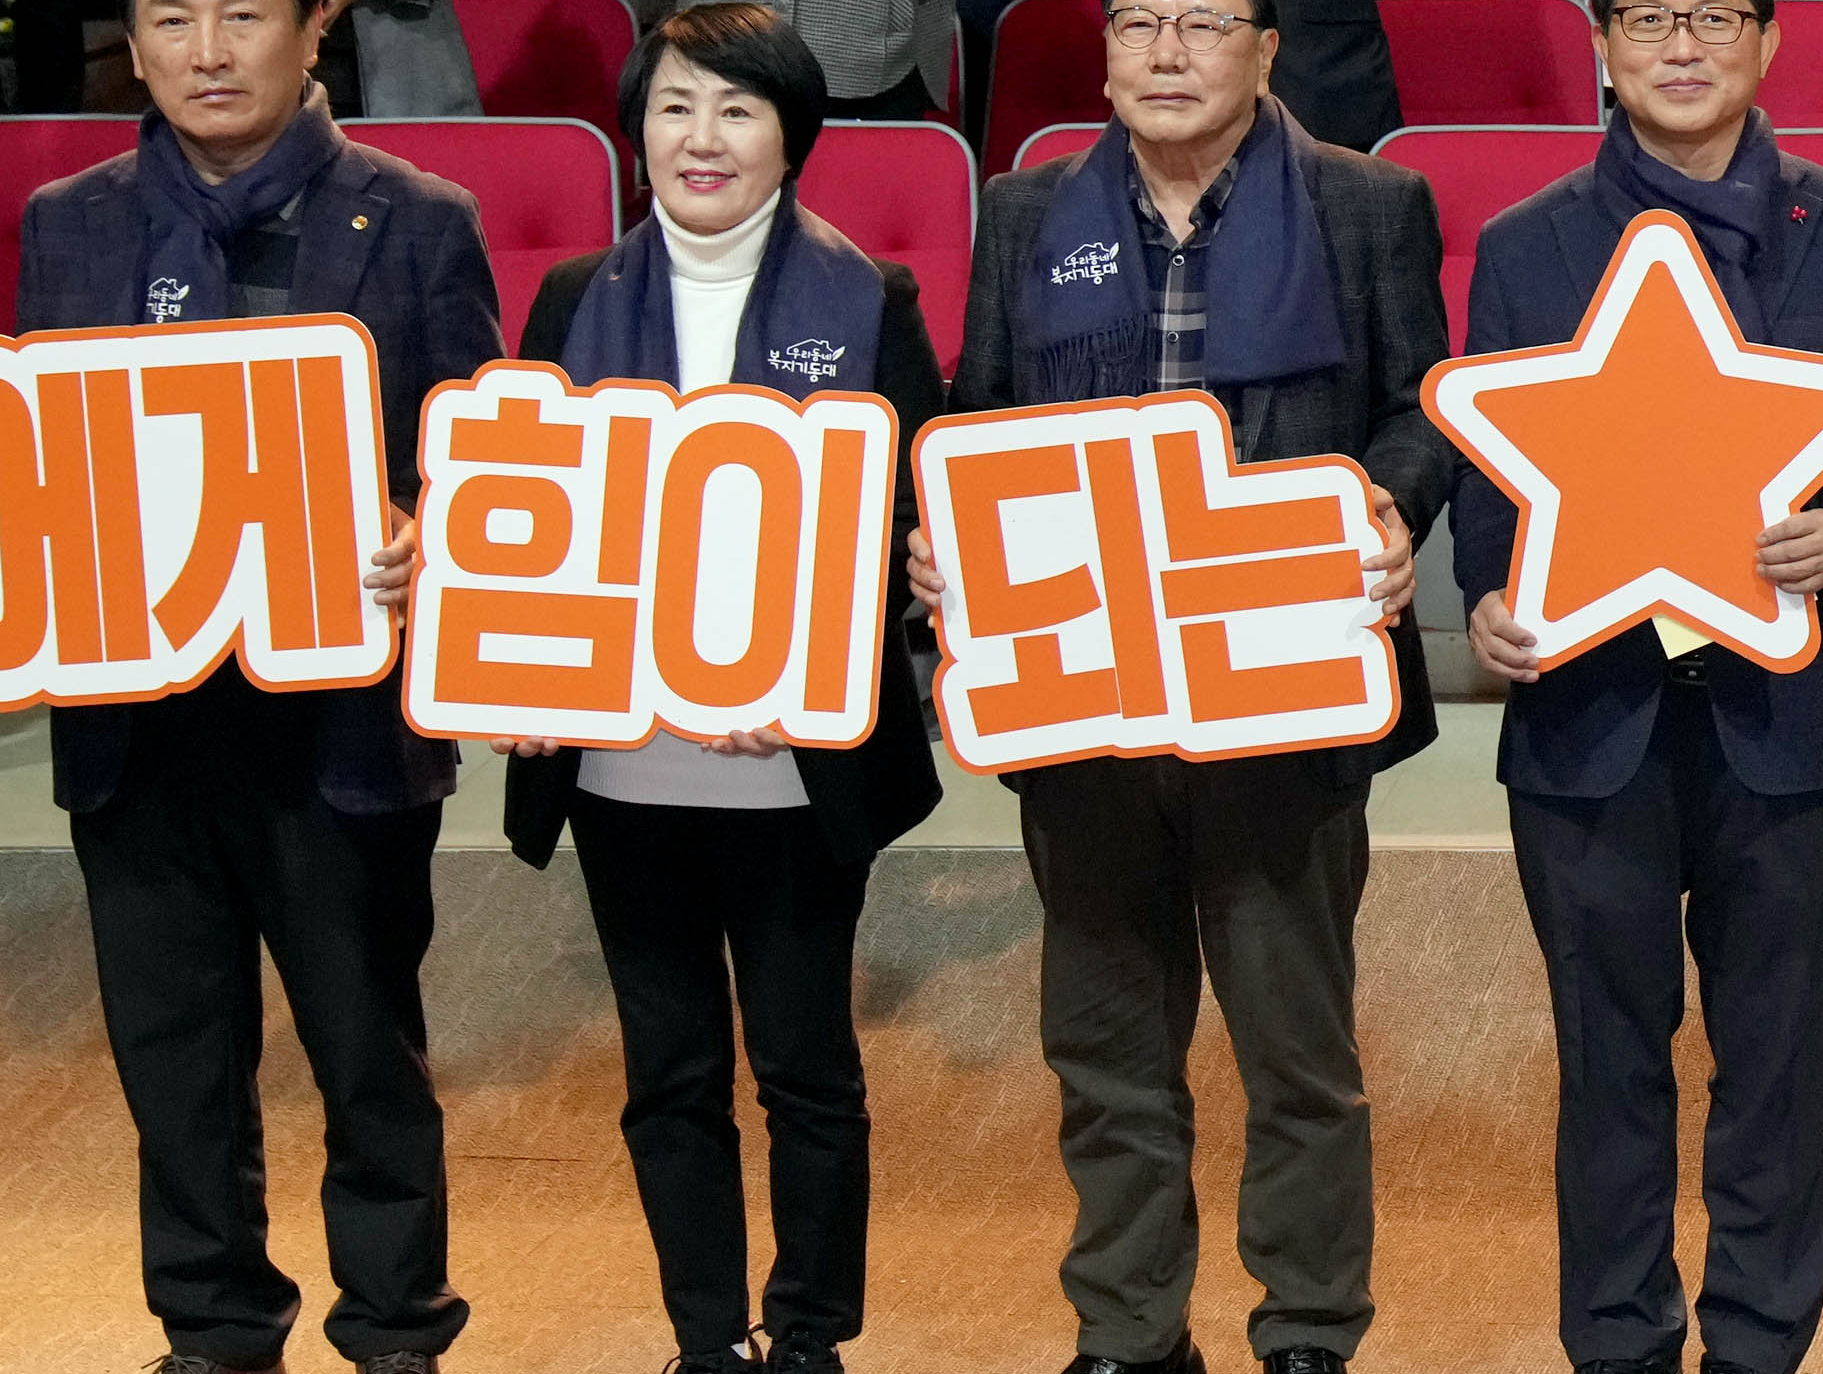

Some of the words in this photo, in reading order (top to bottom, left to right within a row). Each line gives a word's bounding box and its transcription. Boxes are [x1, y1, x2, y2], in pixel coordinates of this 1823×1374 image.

[1070, 253, 1111, 266] 우리동네
[1050, 262, 1119, 287] 복지기동대
[768, 349, 836, 383] 복지기동대
[790, 348, 833, 361] 우리동네
[435, 398, 864, 712] 힘이
[946, 431, 1365, 735] 되는
